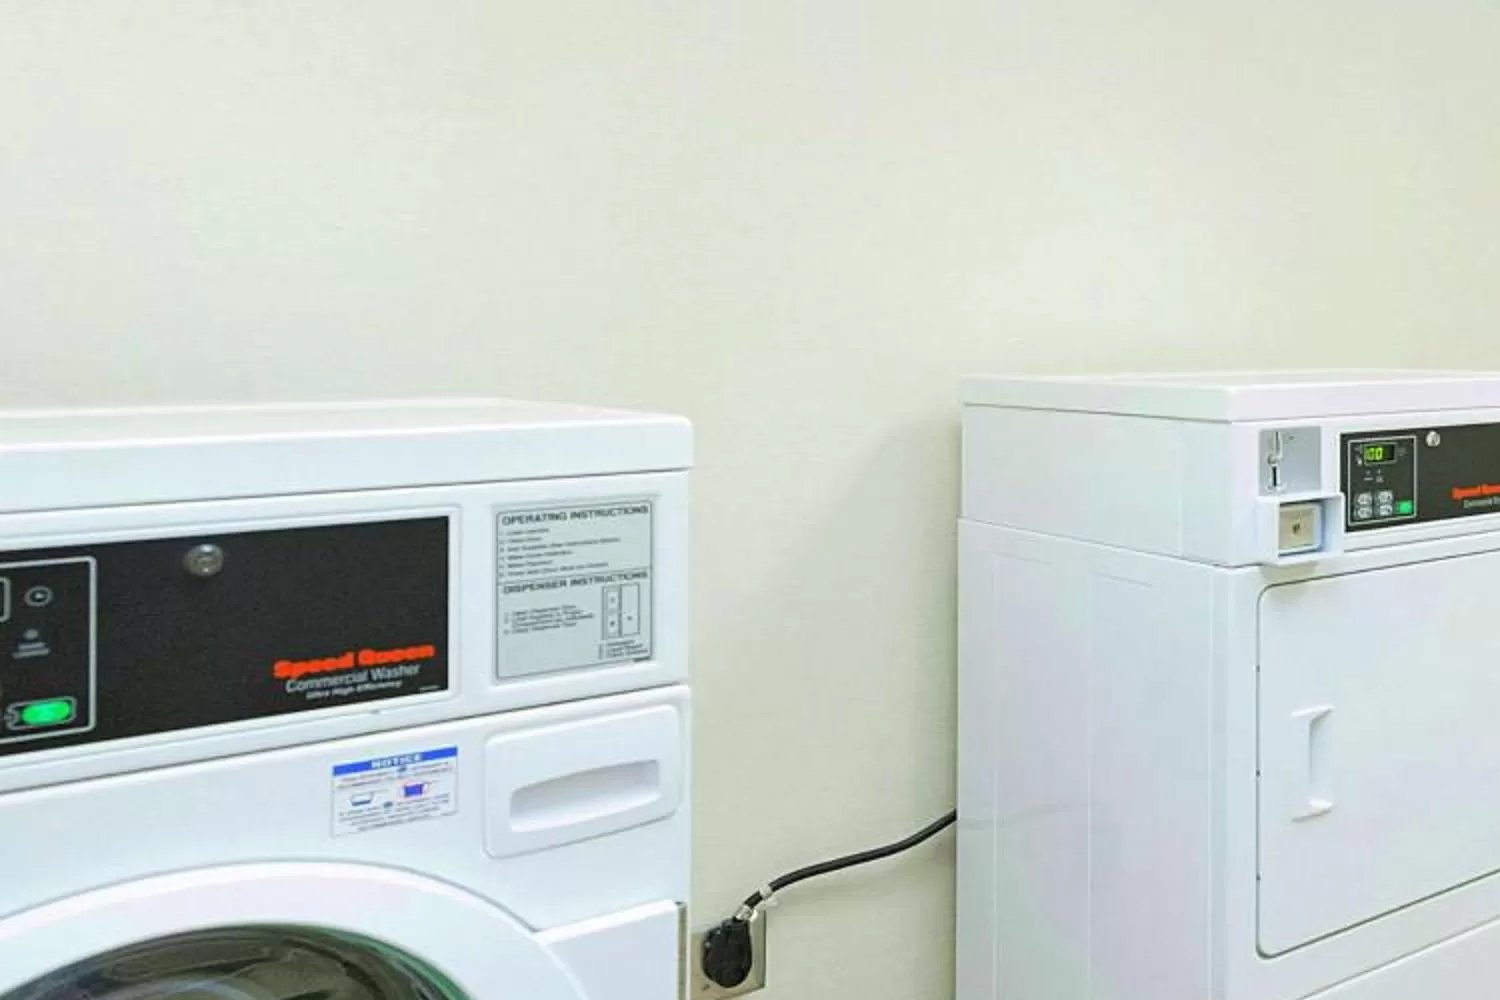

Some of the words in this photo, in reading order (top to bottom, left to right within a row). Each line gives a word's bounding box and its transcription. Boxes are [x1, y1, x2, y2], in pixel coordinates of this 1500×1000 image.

[502, 511, 567, 525] OPERATING
[570, 505, 648, 520] INSTRUCTIONS
[503, 580, 567, 594] DISPENSER
[570, 571, 648, 586] INSTRUCTIONS
[273, 652, 355, 679] Speed
[358, 644, 436, 666] Queen
[286, 669, 368, 693] Commercial
[370, 664, 421, 681] Washer
[371, 753, 422, 769] NOTICE
